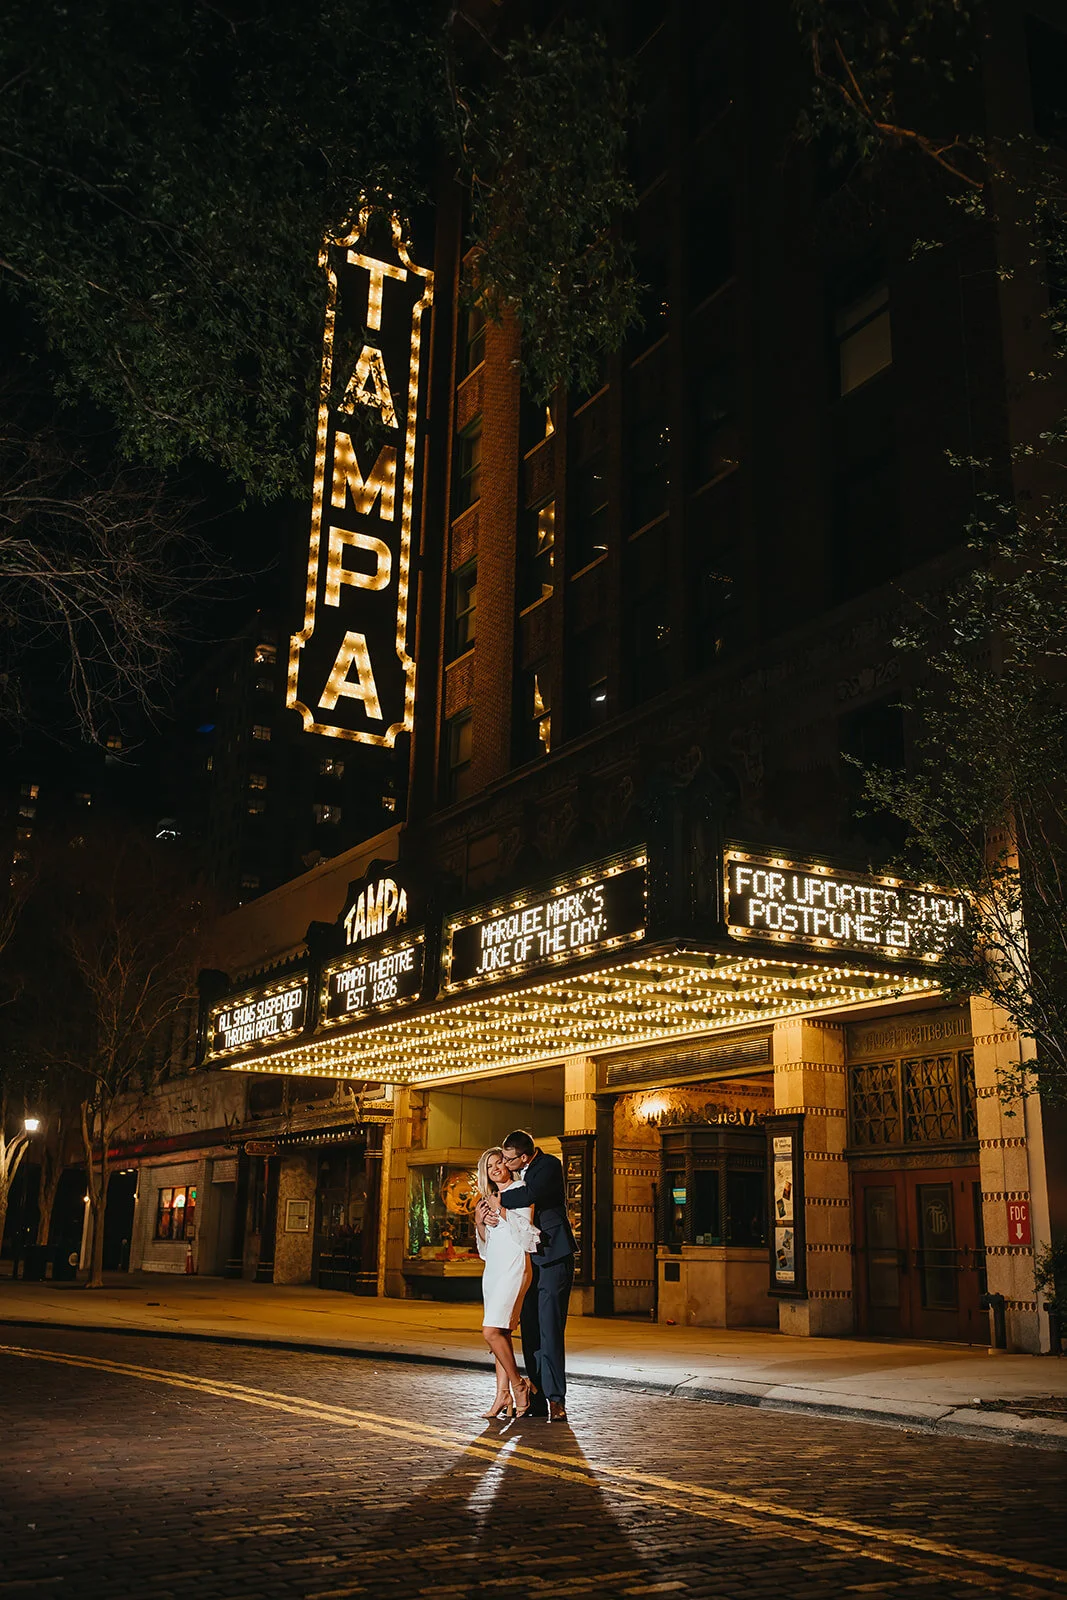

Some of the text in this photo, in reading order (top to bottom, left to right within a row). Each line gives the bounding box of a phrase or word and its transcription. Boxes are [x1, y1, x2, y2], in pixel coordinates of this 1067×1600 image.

[317, 250, 407, 720] TAMPA
[343, 878, 408, 946] TAMPA
[735, 866, 786, 900] FOR
[793, 875, 900, 918] UPDATED
[480, 885, 605, 949] MARQUEE MARK'S
[475, 913, 608, 975] JOKE OF THE DAY:
[335, 947, 415, 994] TAMPA THEATRE
[346, 976, 398, 1011] EST. 1926
[218, 988, 303, 1032] ALL SHOWS SUSPENDED
[224, 1022, 256, 1048] THROUGH
[255, 1015, 280, 1040] APRIL
[1010, 1205, 1026, 1221] FDC
